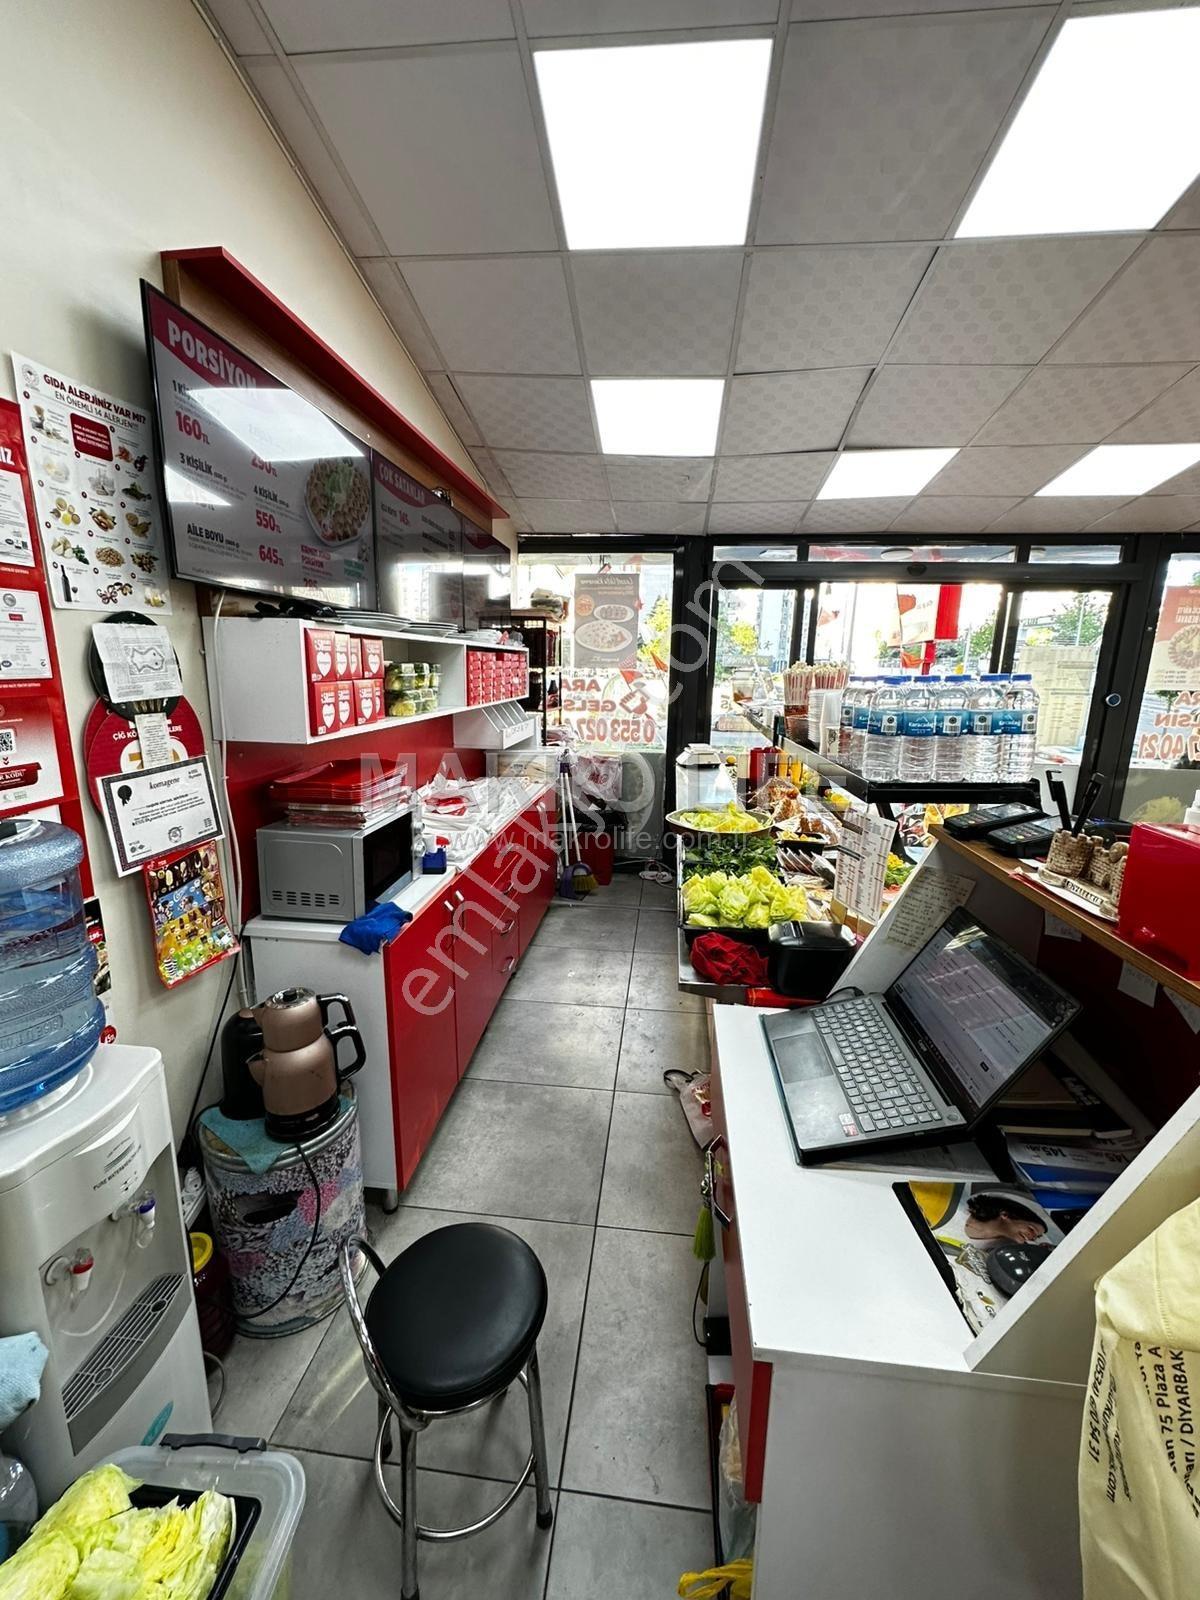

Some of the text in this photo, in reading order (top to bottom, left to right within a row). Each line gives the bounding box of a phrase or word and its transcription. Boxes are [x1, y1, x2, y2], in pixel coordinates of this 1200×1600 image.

[44, 374, 66, 392] GIDA
[68, 385, 112, 412] ALERJİNİZ
[113, 404, 131, 419] VAR
[55, 390, 66, 402] EN
[66, 394, 94, 414] ÖNEMLİ
[179, 452, 213, 476] 3 KİŞİLİK
[186, 522, 224, 543] AİLE BOYU
[127, 730, 138, 739] KÖ
[168, 724, 182, 733] LERE
[1153, 1364, 1171, 1408] Plaza
[1159, 1414, 1174, 1434] 75
